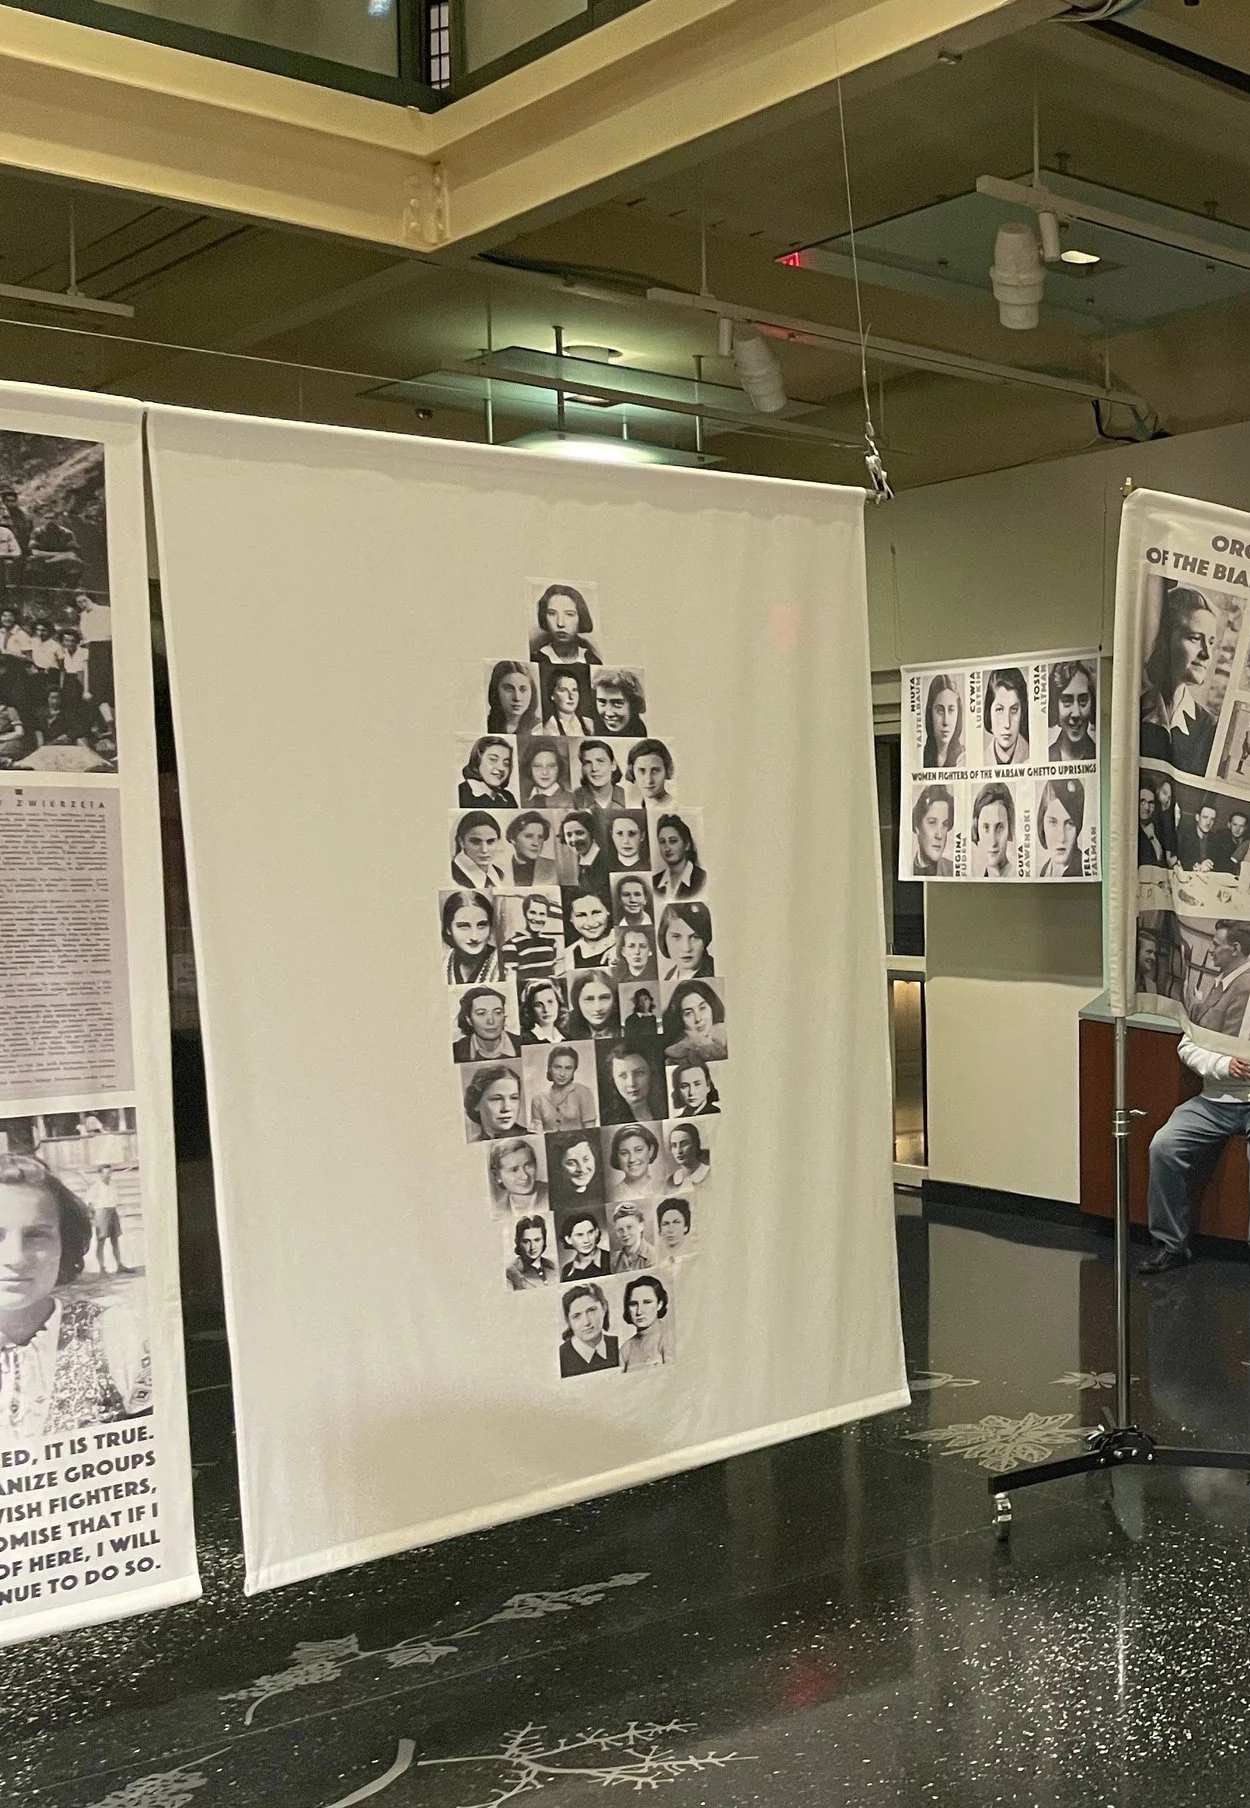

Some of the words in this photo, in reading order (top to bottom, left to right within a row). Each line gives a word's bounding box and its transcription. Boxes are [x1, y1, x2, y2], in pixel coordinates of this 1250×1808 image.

[1145, 546, 1170, 567] OF
[1171, 551, 1210, 577] THE
[912, 772, 937, 781] WOMEN
[938, 770, 968, 780] FIGHTERS
[970, 770, 979, 779] OF
[980, 769, 992, 779] THE
[994, 768, 1025, 778] WARSAW
[1027, 766, 1057, 777] GHETTO
[1058, 763, 1097, 775] UPRISINGS
[1, 1450, 37, 1468] ED,
[45, 1442, 63, 1460] IT
[70, 1437, 87, 1455] IS
[94, 1425, 154, 1450] TRUE.
[0, 1471, 57, 1496] NIZE
[64, 1450, 156, 1483] GROUPS
[0, 1501, 42, 1524] ISH
[50, 1478, 157, 1514] FIGHTERS,
[68, 1511, 122, 1537] THAT
[128, 1505, 146, 1523] IF
[152, 1503, 158, 1518] I
[29, 1547, 90, 1573] HERE,
[97, 1542, 103, 1557] I
[110, 1529, 160, 1553] WILL
[48, 1575, 78, 1594] TO
[85, 1565, 119, 1586] DO
[125, 1556, 161, 1577] SO.
